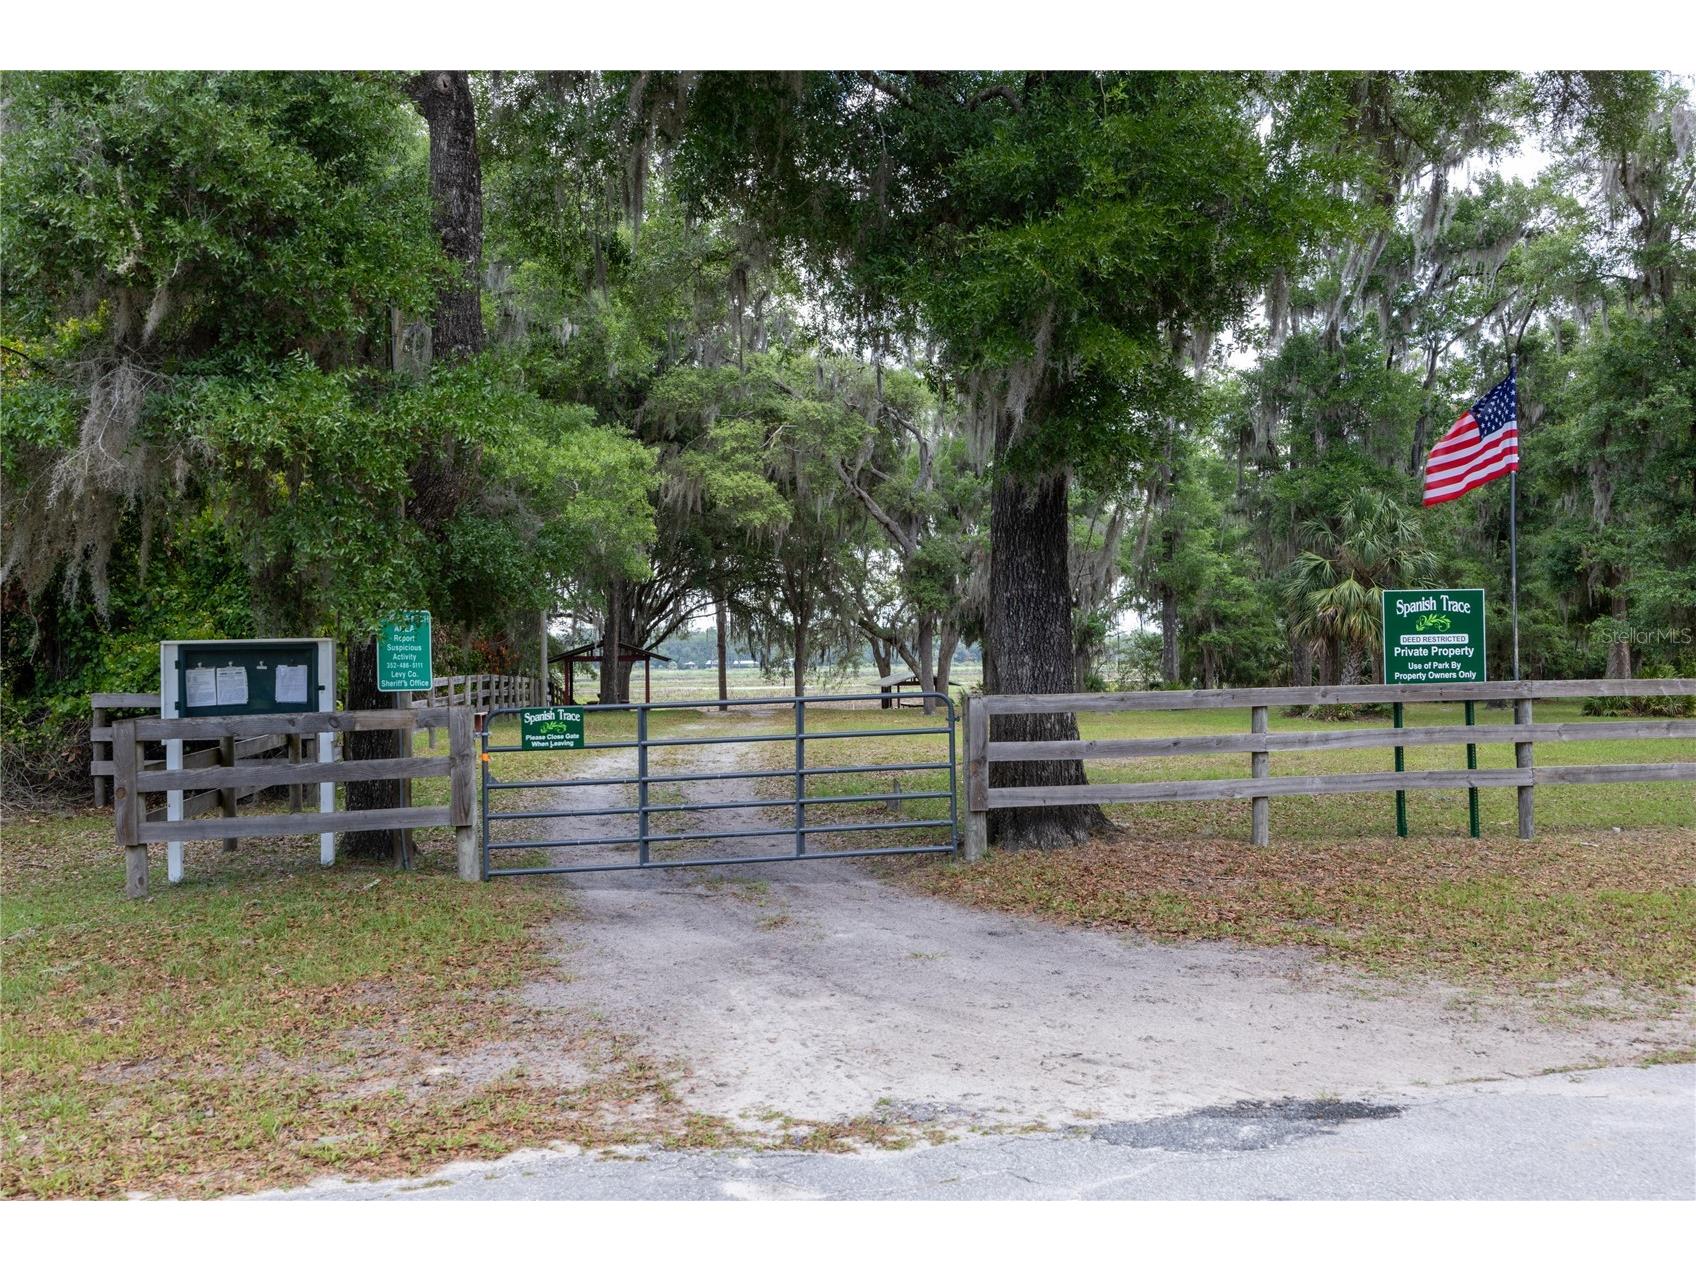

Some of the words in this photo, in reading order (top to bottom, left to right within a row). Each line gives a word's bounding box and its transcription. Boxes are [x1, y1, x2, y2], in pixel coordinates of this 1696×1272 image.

[1396, 596, 1437, 617] Spanish
[1440, 595, 1471, 614] Trace
[1422, 635, 1466, 643] RESTRICTED
[386, 643, 422, 653] Suspicious
[1394, 647, 1429, 657] Private
[1431, 646, 1474, 658] Property
[392, 653, 417, 662] Activity
[1408, 662, 1422, 670] Use
[1424, 662, 1432, 670] of
[1432, 661, 1450, 670] Park
[1451, 661, 1461, 671] By
[391, 670, 406, 679] Levy
[1394, 672, 1426, 681] Property
[1428, 671, 1457, 679] Owners
[1458, 670, 1477, 679] Only
[409, 679, 429, 687] Office
[524, 710, 555, 725] Spanish
[557, 708, 581, 721] Trace
[550, 740, 574, 748] Leaving
